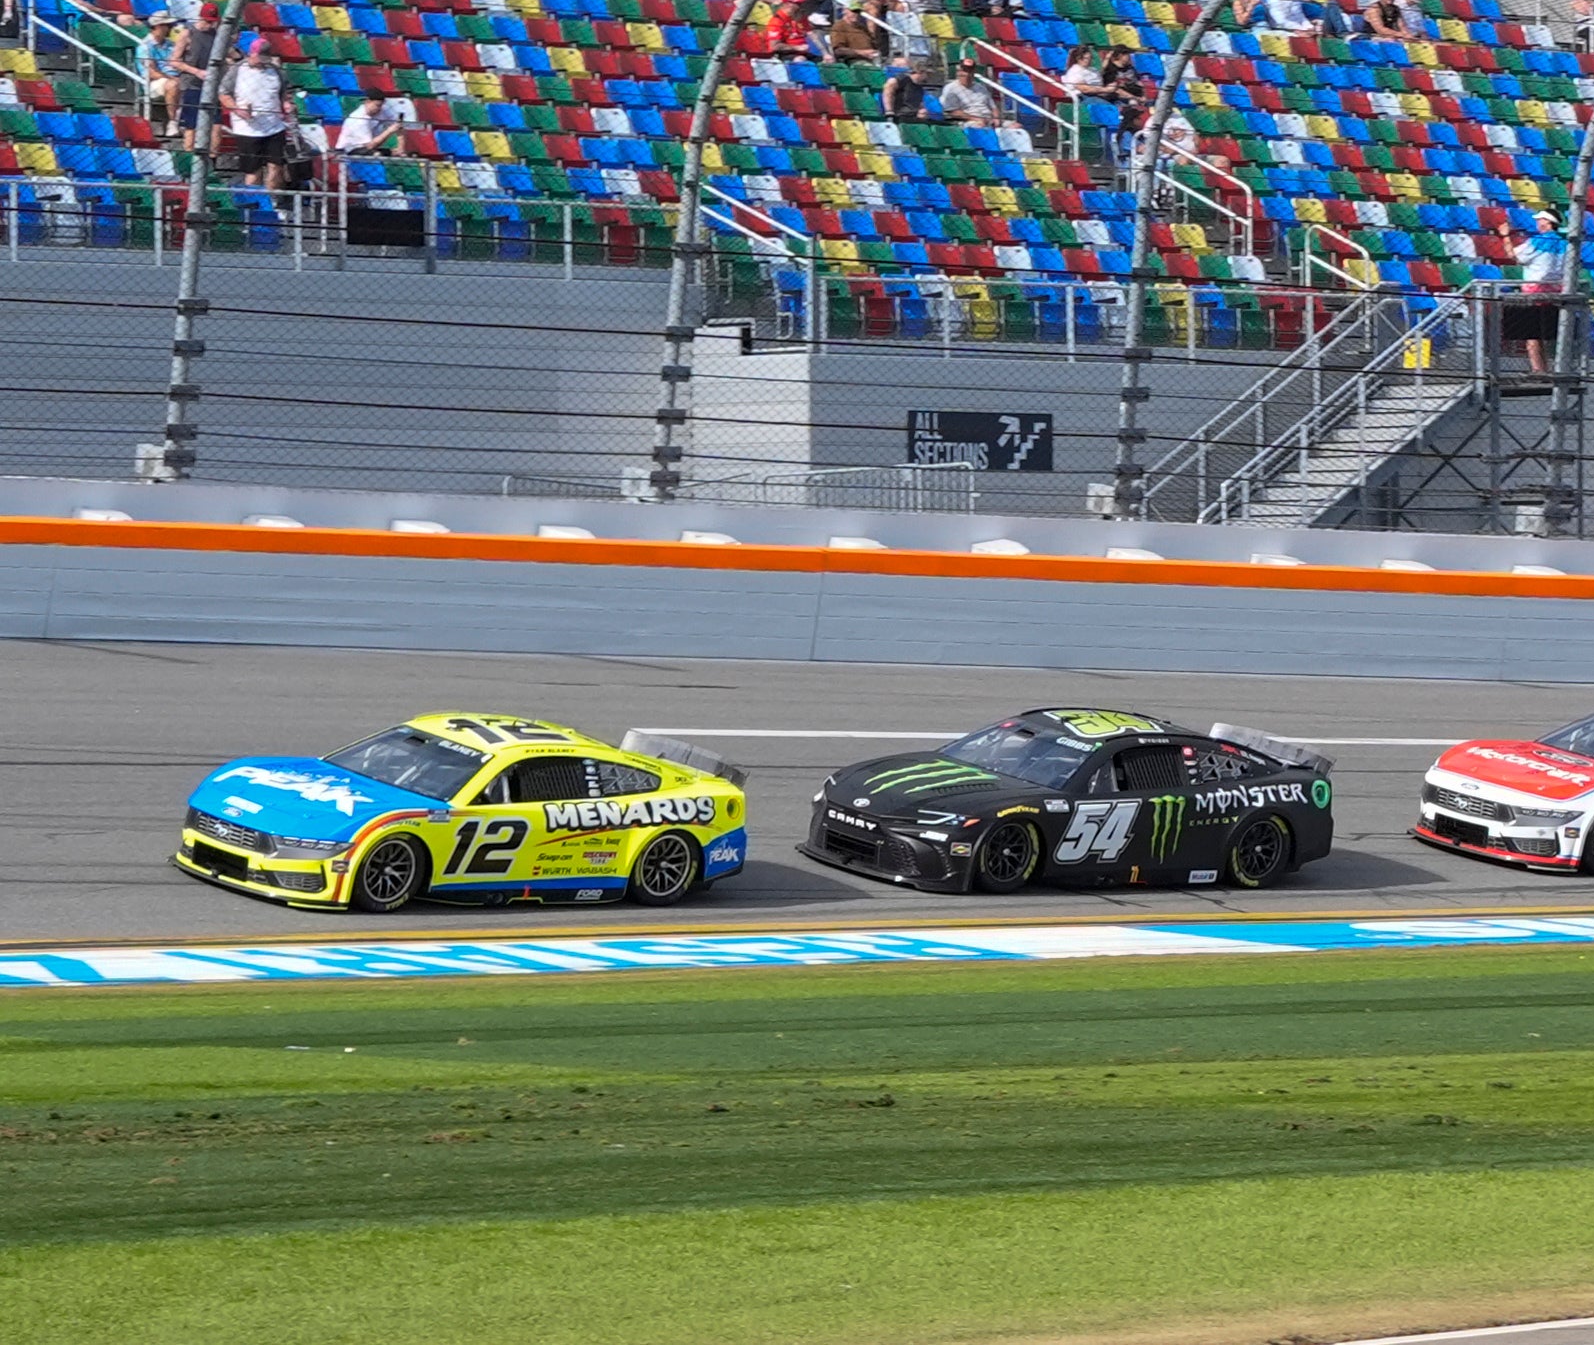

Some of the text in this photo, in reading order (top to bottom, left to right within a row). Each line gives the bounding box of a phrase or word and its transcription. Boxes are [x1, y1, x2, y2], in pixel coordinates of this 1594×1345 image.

[914, 412, 939, 440] ALL
[914, 443, 988, 470] SECTIONS
[438, 740, 480, 757] BLANEY
[1056, 736, 1093, 752] GIBBS
[1466, 746, 1592, 787] Motorcraft
[545, 796, 715, 832] MENARDS
[1189, 816, 1239, 826] ENERGY
[1053, 798, 1142, 865] 54
[442, 818, 529, 876] 12
[708, 847, 739, 865] PEAK
[577, 889, 603, 898] FORD
